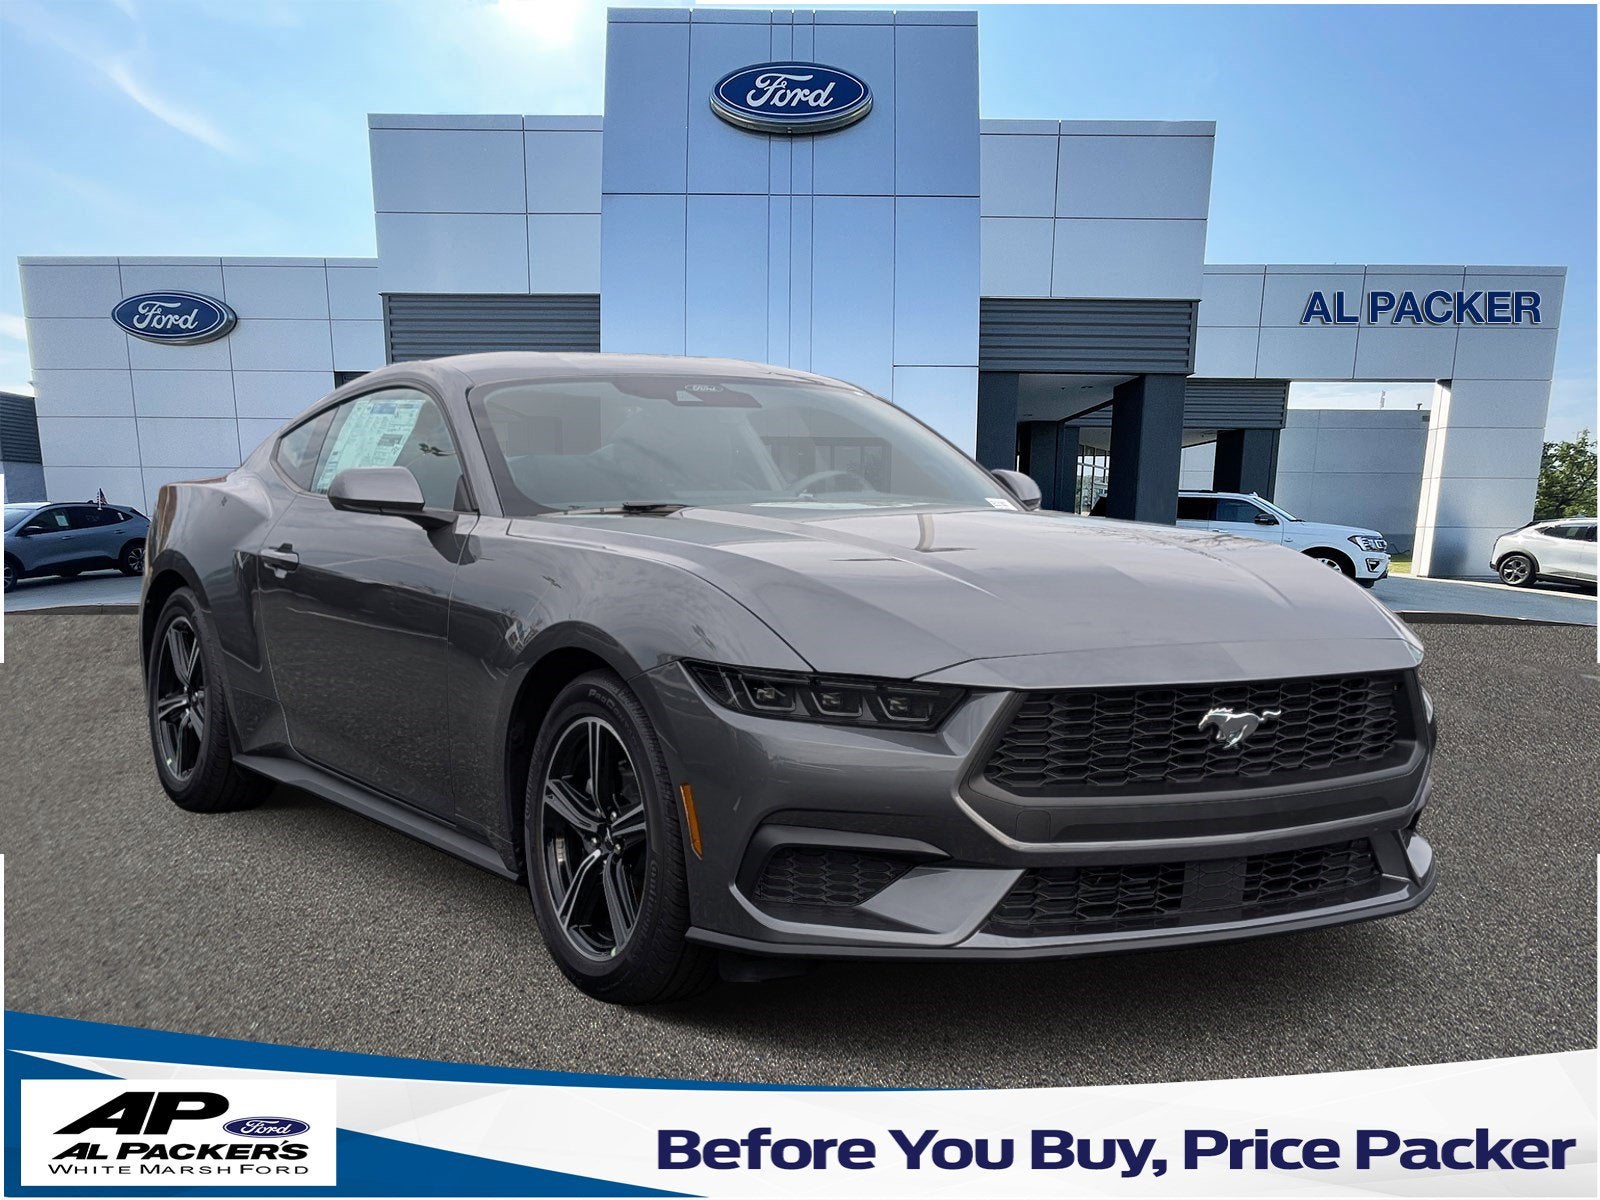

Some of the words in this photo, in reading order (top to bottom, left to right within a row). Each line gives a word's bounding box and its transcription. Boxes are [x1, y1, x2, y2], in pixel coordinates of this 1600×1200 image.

[746, 73, 836, 107] Ford
[133, 301, 199, 330] Ford
[1301, 290, 1359, 324] AL
[1369, 289, 1542, 324] PACKER
